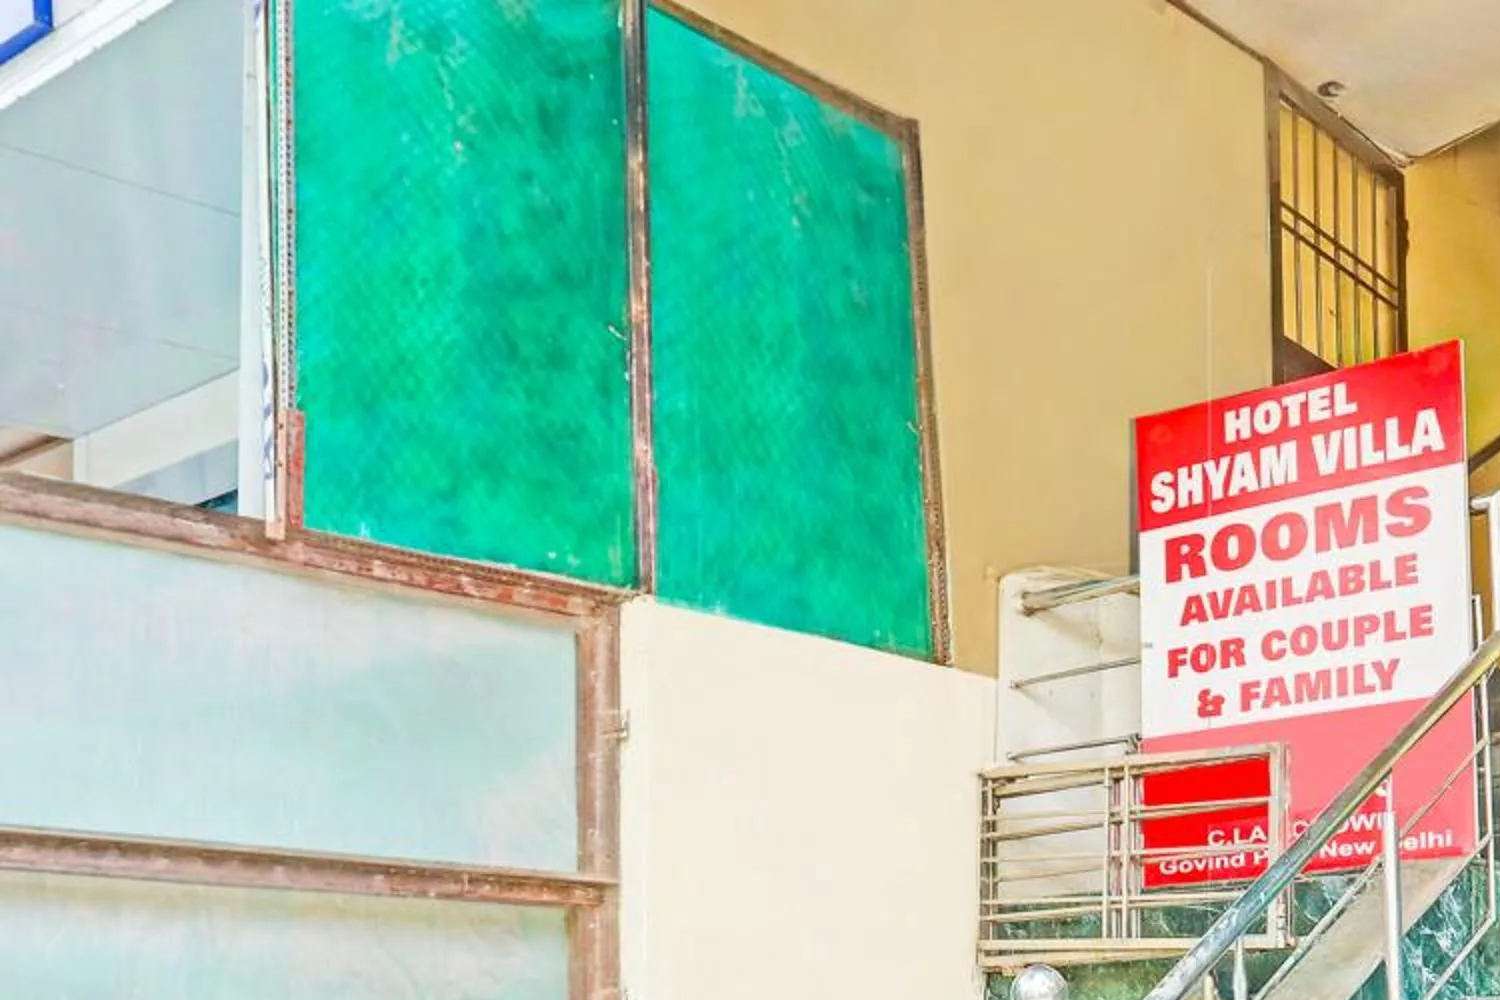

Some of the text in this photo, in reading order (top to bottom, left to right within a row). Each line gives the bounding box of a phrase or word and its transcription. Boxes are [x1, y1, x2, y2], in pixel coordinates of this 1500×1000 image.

[1223, 382, 1358, 444] HOTEL
[1150, 408, 1447, 514] SHYAM VILLA
[1163, 485, 1433, 585] ROOMS
[1179, 552, 1420, 628] AVAILABLE
[1166, 604, 1435, 679] FOR COUPLE
[1196, 658, 1401, 719] & FAMILY
[1159, 850, 1246, 876] Govind
[1319, 839, 1377, 859] New
[1397, 829, 1454, 852] elhi
